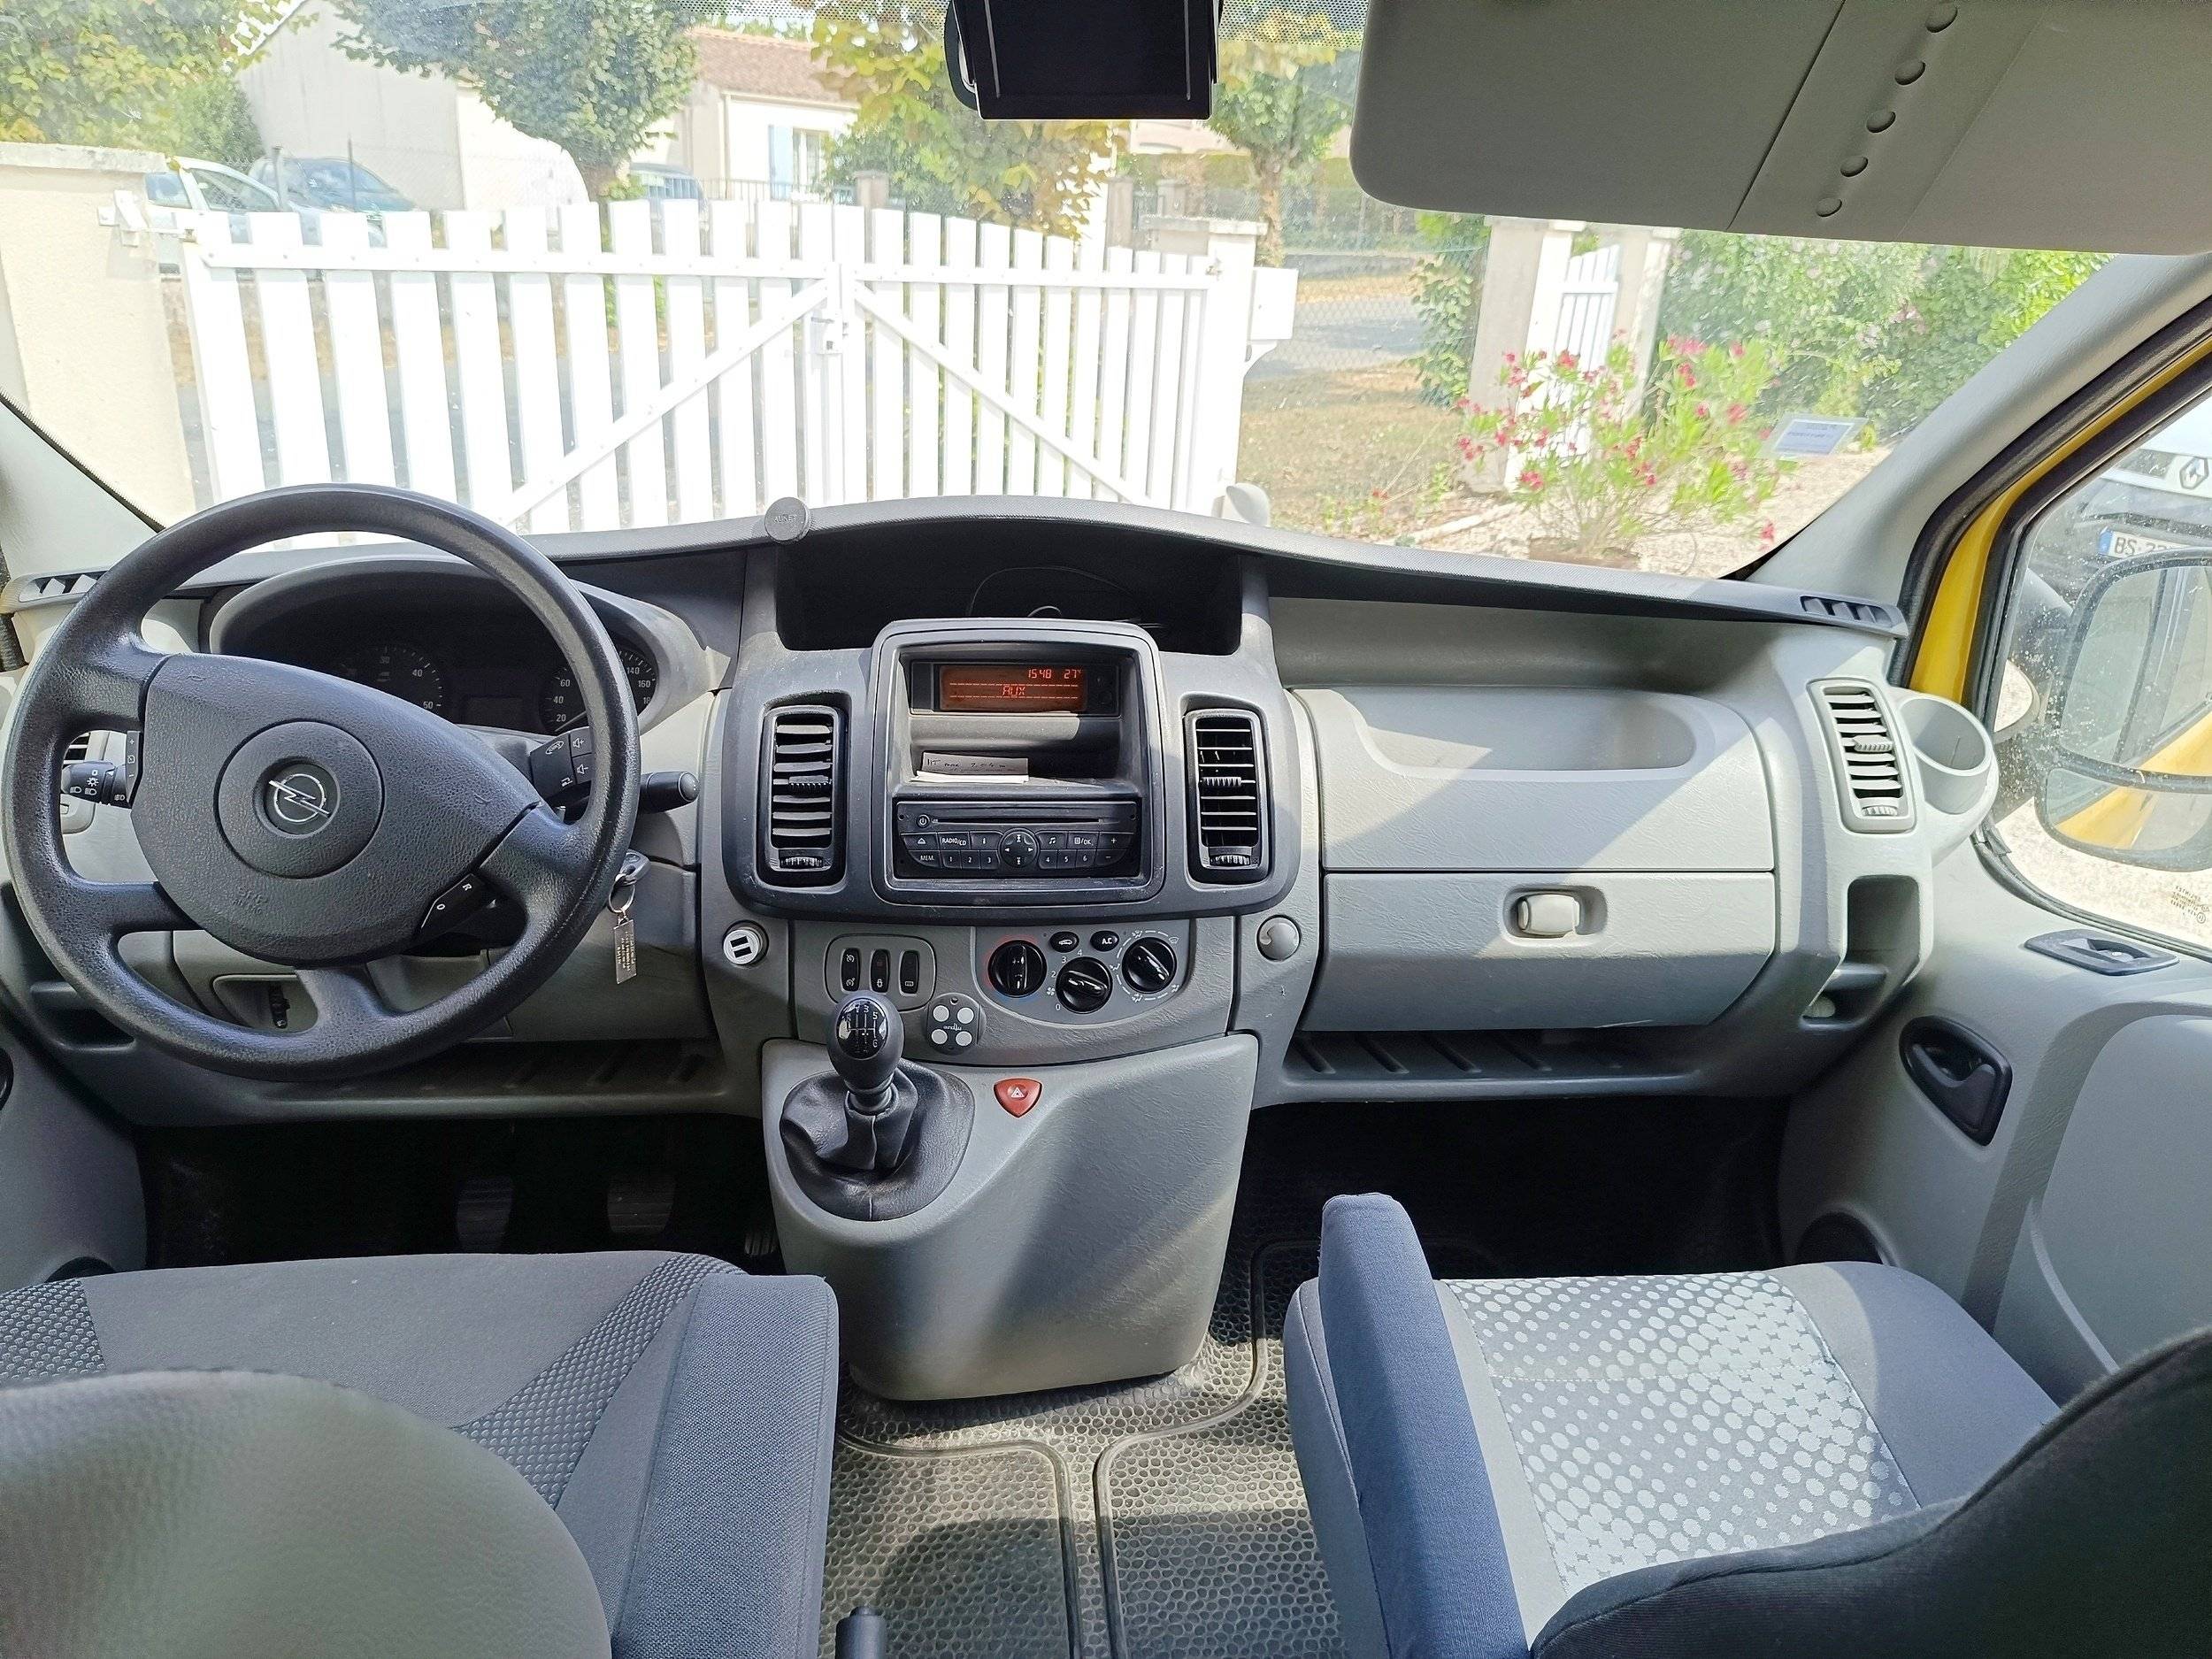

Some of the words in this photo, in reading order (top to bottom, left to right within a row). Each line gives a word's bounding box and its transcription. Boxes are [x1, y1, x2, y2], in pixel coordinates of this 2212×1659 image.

[560, 679, 571, 687] 60
[638, 680, 651, 688] 160
[1002, 685, 1025, 697] AUX
[553, 695, 564, 704] 40
[557, 713, 566, 722] 20
[864, 1004, 870, 1013] 3
[872, 1011, 879, 1020] 5
[872, 1039, 879, 1048] 6
